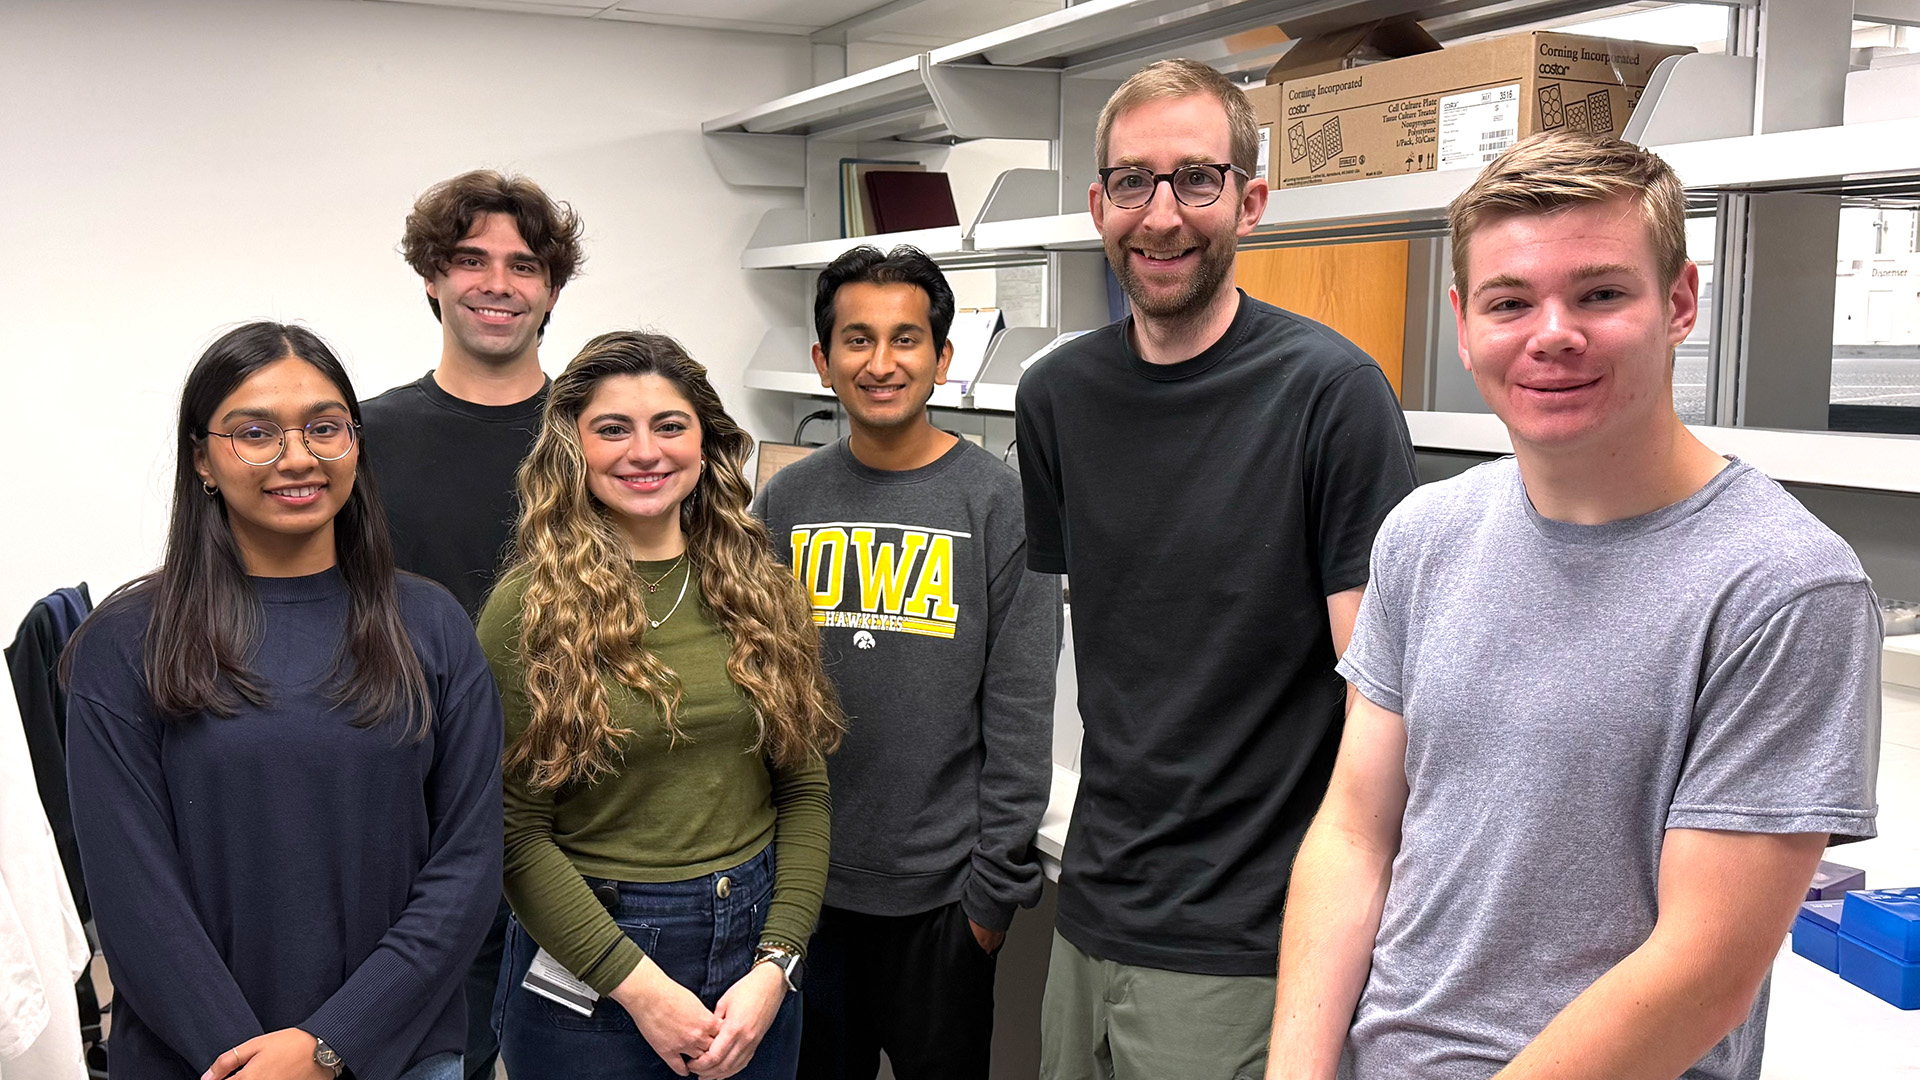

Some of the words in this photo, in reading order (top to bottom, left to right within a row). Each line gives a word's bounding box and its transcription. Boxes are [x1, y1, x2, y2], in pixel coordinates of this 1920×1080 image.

[1540, 43, 1578, 62] Corning
[1581, 47, 1640, 66] Incorporated
[1539, 63, 1570, 75] costar
[1288, 88, 1316, 101] Corning
[1317, 76, 1363, 96] Incorporated
[1288, 104, 1310, 116] costar
[1388, 102, 1399, 113] Cell
[1400, 99, 1421, 112] Culture
[1423, 97, 1437, 108] Plate
[1398, 109, 1417, 121] Culture
[1417, 107, 1437, 118] Treated
[1401, 117, 1437, 130] Nonpyrogenic
[790, 527, 959, 622] IOWA
[825, 610, 903, 632] HAWKEYES
